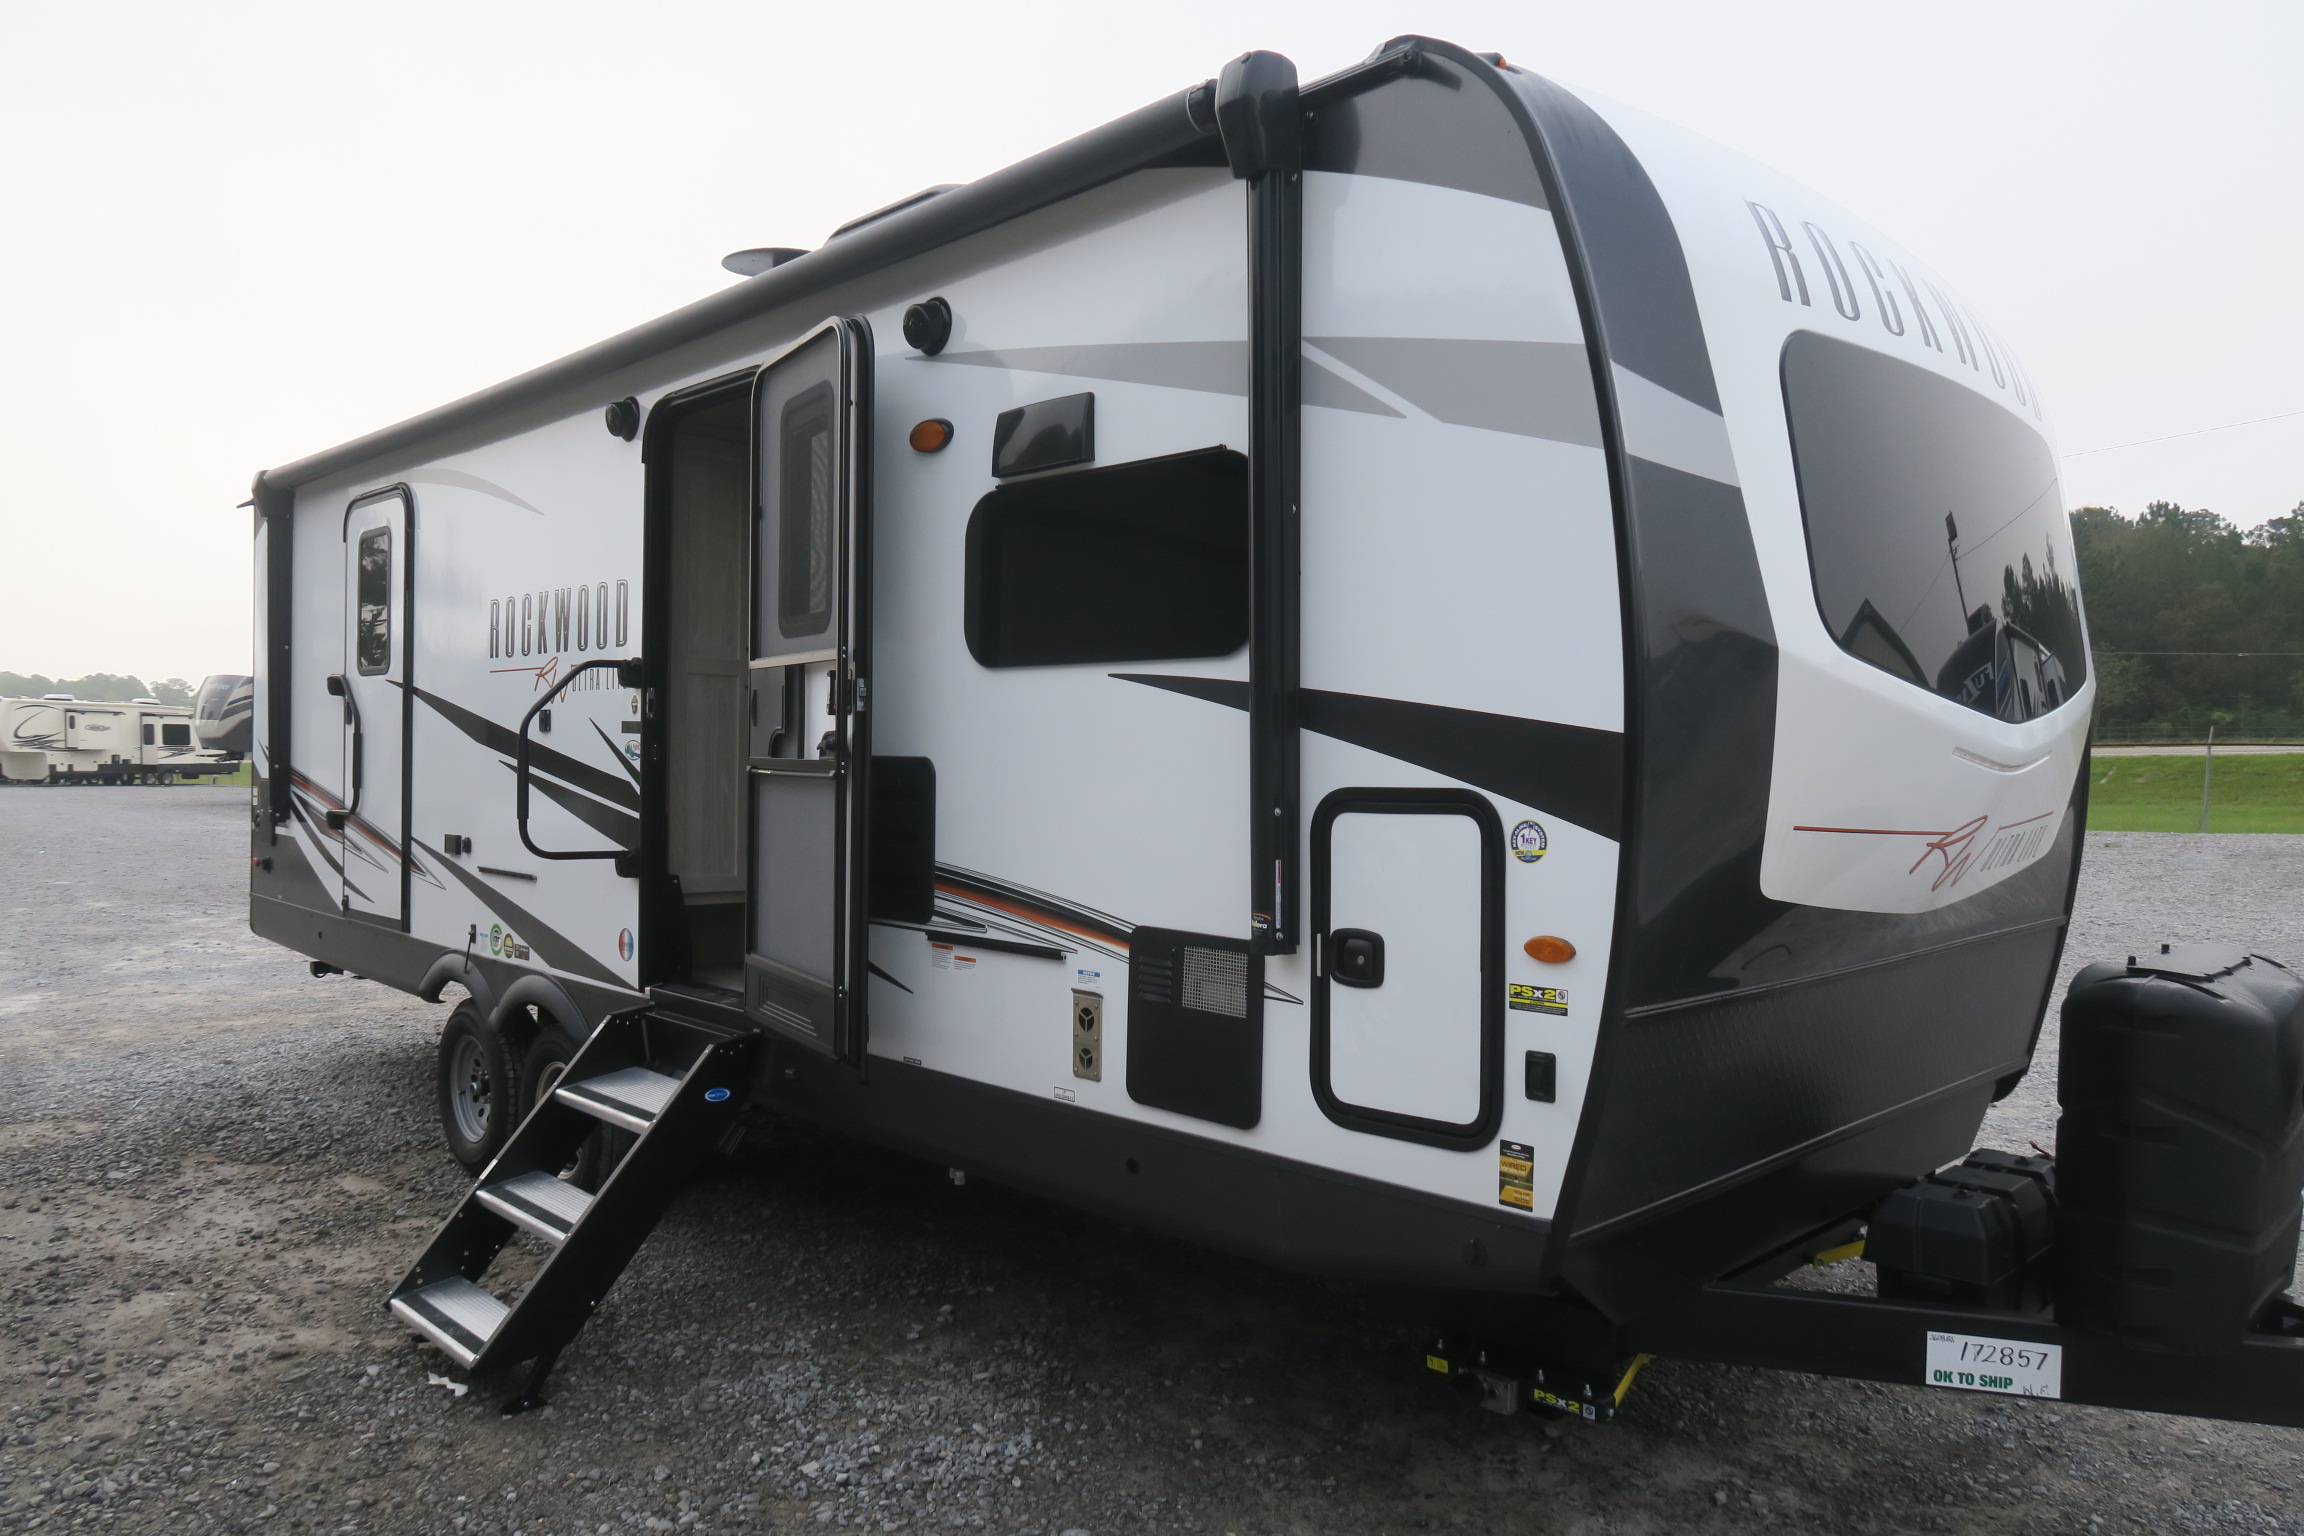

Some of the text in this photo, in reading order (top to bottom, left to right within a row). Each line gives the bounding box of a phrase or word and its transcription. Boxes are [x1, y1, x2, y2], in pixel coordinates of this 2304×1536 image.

[489, 579, 629, 659] ROCKWOOD
[1509, 984, 1556, 1000] PSx2
[1960, 1341, 2049, 1371] 172857
[1933, 1369, 2013, 1390] OK TO SHIP
